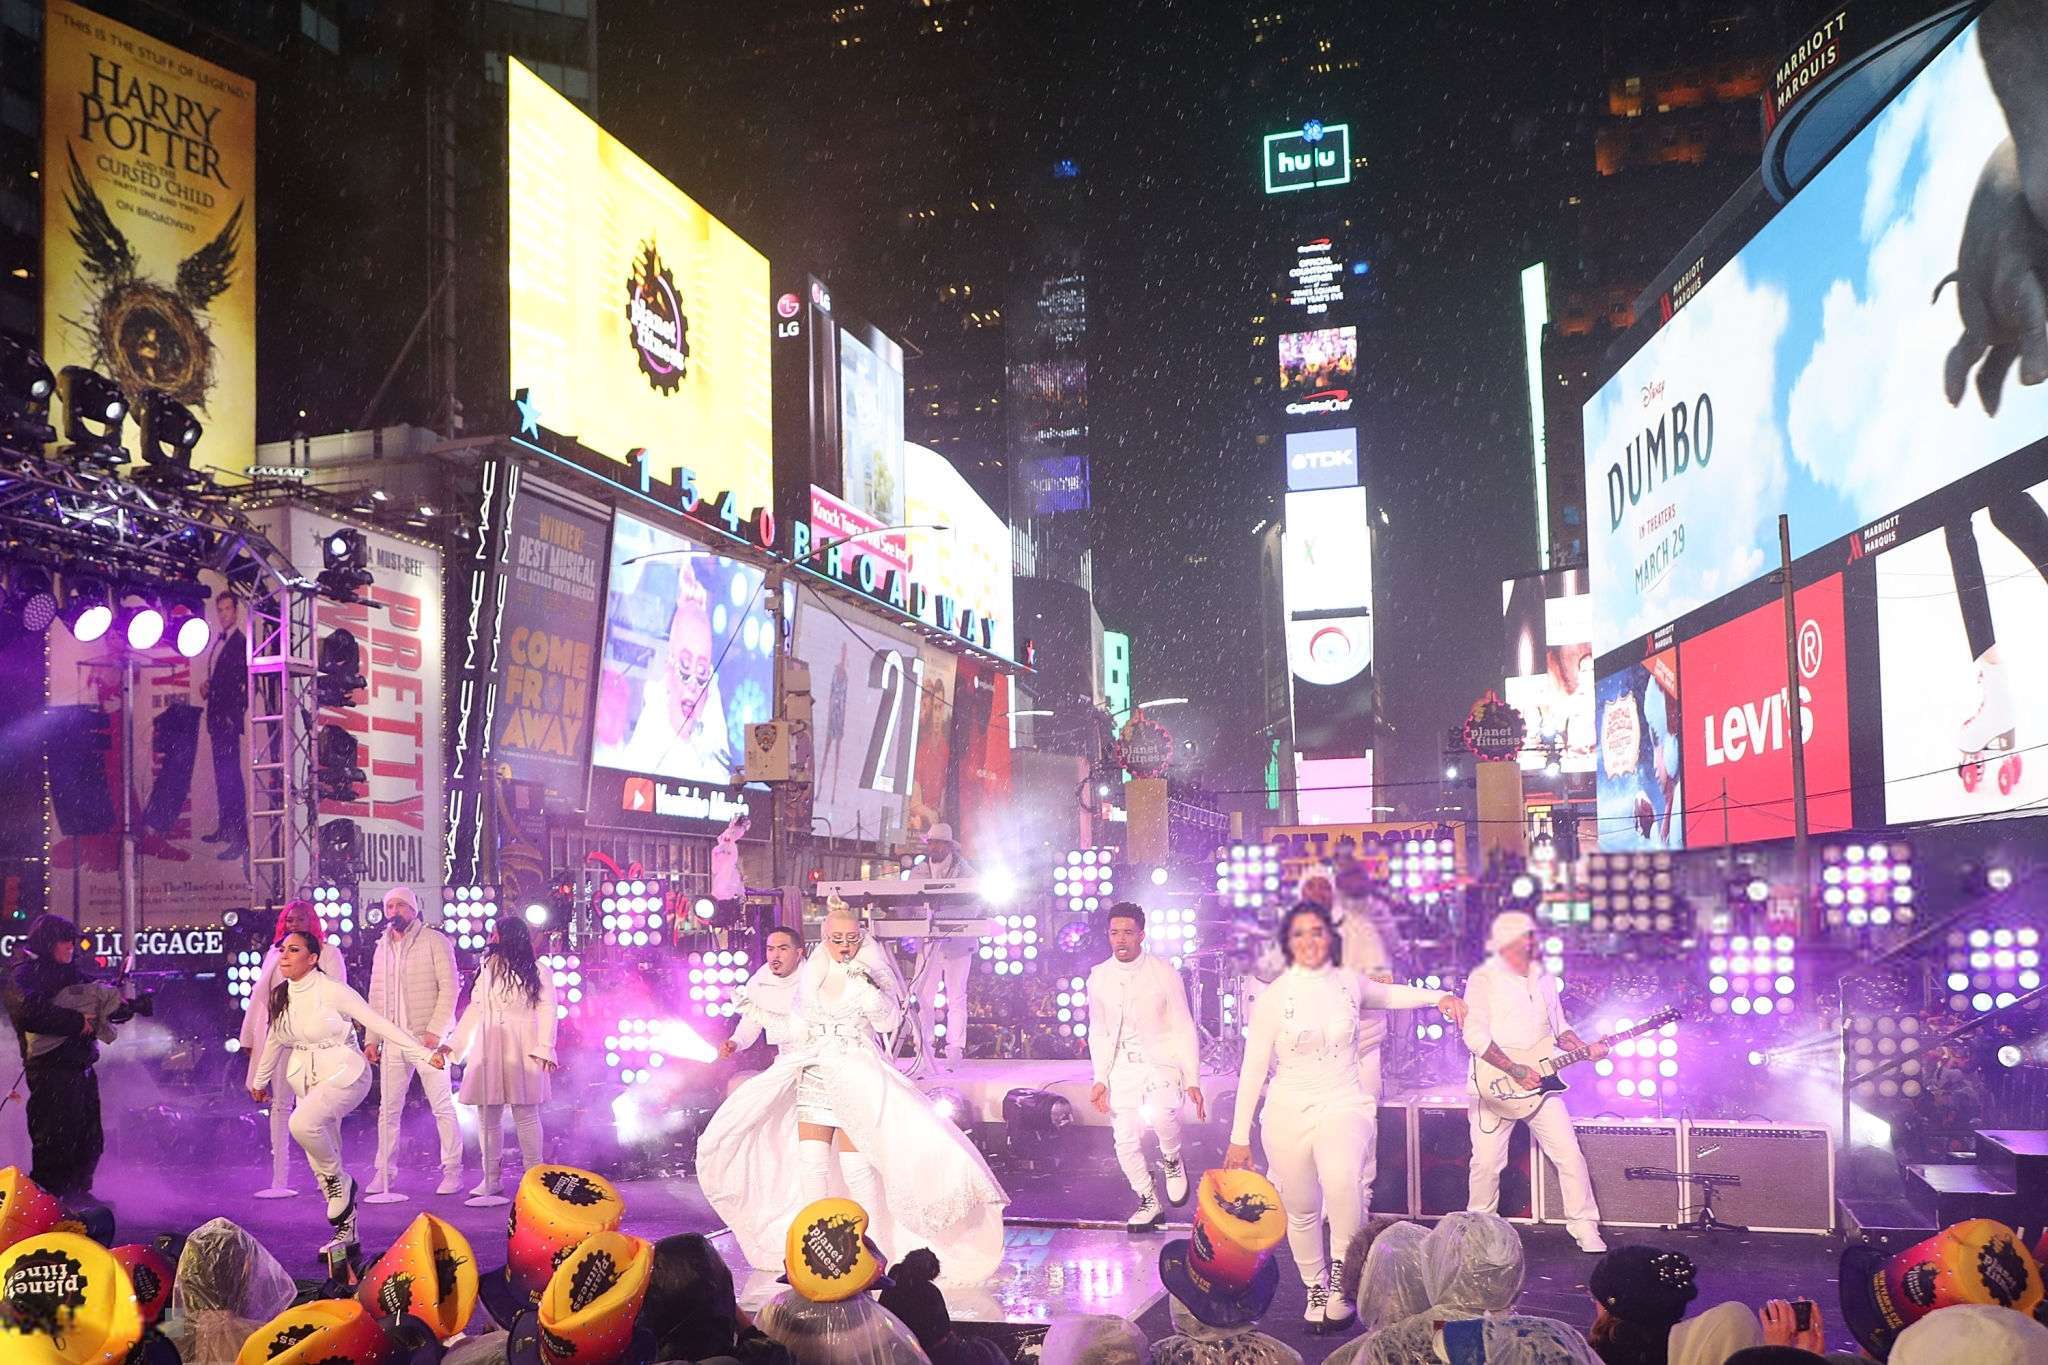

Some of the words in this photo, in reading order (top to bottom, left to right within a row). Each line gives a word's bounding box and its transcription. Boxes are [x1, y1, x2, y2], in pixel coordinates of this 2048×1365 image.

[1775, 11, 1847, 89] MARRIOTT
[90, 52, 222, 145] HARRY
[1776, 45, 1837, 112] MARQUIS
[79, 91, 232, 189] POTTER
[1278, 147, 1335, 173] hulu
[96, 154, 161, 189] CURSED
[166, 179, 215, 208] CHILD
[116, 200, 134, 213] ON
[137, 207, 196, 233] BROADWAY
[1673, 256, 1705, 296] MARRIOTT
[1673, 277, 1702, 312] MARQUIS
[778, 321, 800, 337] LG
[1640, 379, 1666, 408] Disney
[248, 466, 305, 477] LAMAR
[1305, 448, 1353, 468] TDK
[1607, 392, 1714, 534] DUMBO
[1638, 524, 1646, 539] IN
[1647, 503, 1677, 534] THEATERS
[1864, 514, 1900, 540] MARRIOTT
[518, 535, 549, 570] BEST
[548, 545, 596, 587] MUSICAL
[1634, 537, 1669, 595] MARCH
[1672, 523, 1685, 559] 29
[1864, 531, 1896, 554] MARQUIS
[793, 520, 998, 650] BROADWAY
[511, 626, 592, 680] COME
[371, 585, 425, 832] PRETTY
[871, 650, 925, 796] 21
[500, 707, 583, 757] AWAY
[1121, 743, 1159, 757] planet
[1470, 726, 1512, 741] planet
[1476, 735, 1521, 747] fitness
[807, 1236, 841, 1277] fitness
[809, 1227, 844, 1263] planet
[7, 1274, 79, 1300] planet
[573, 1259, 602, 1310] fitness
